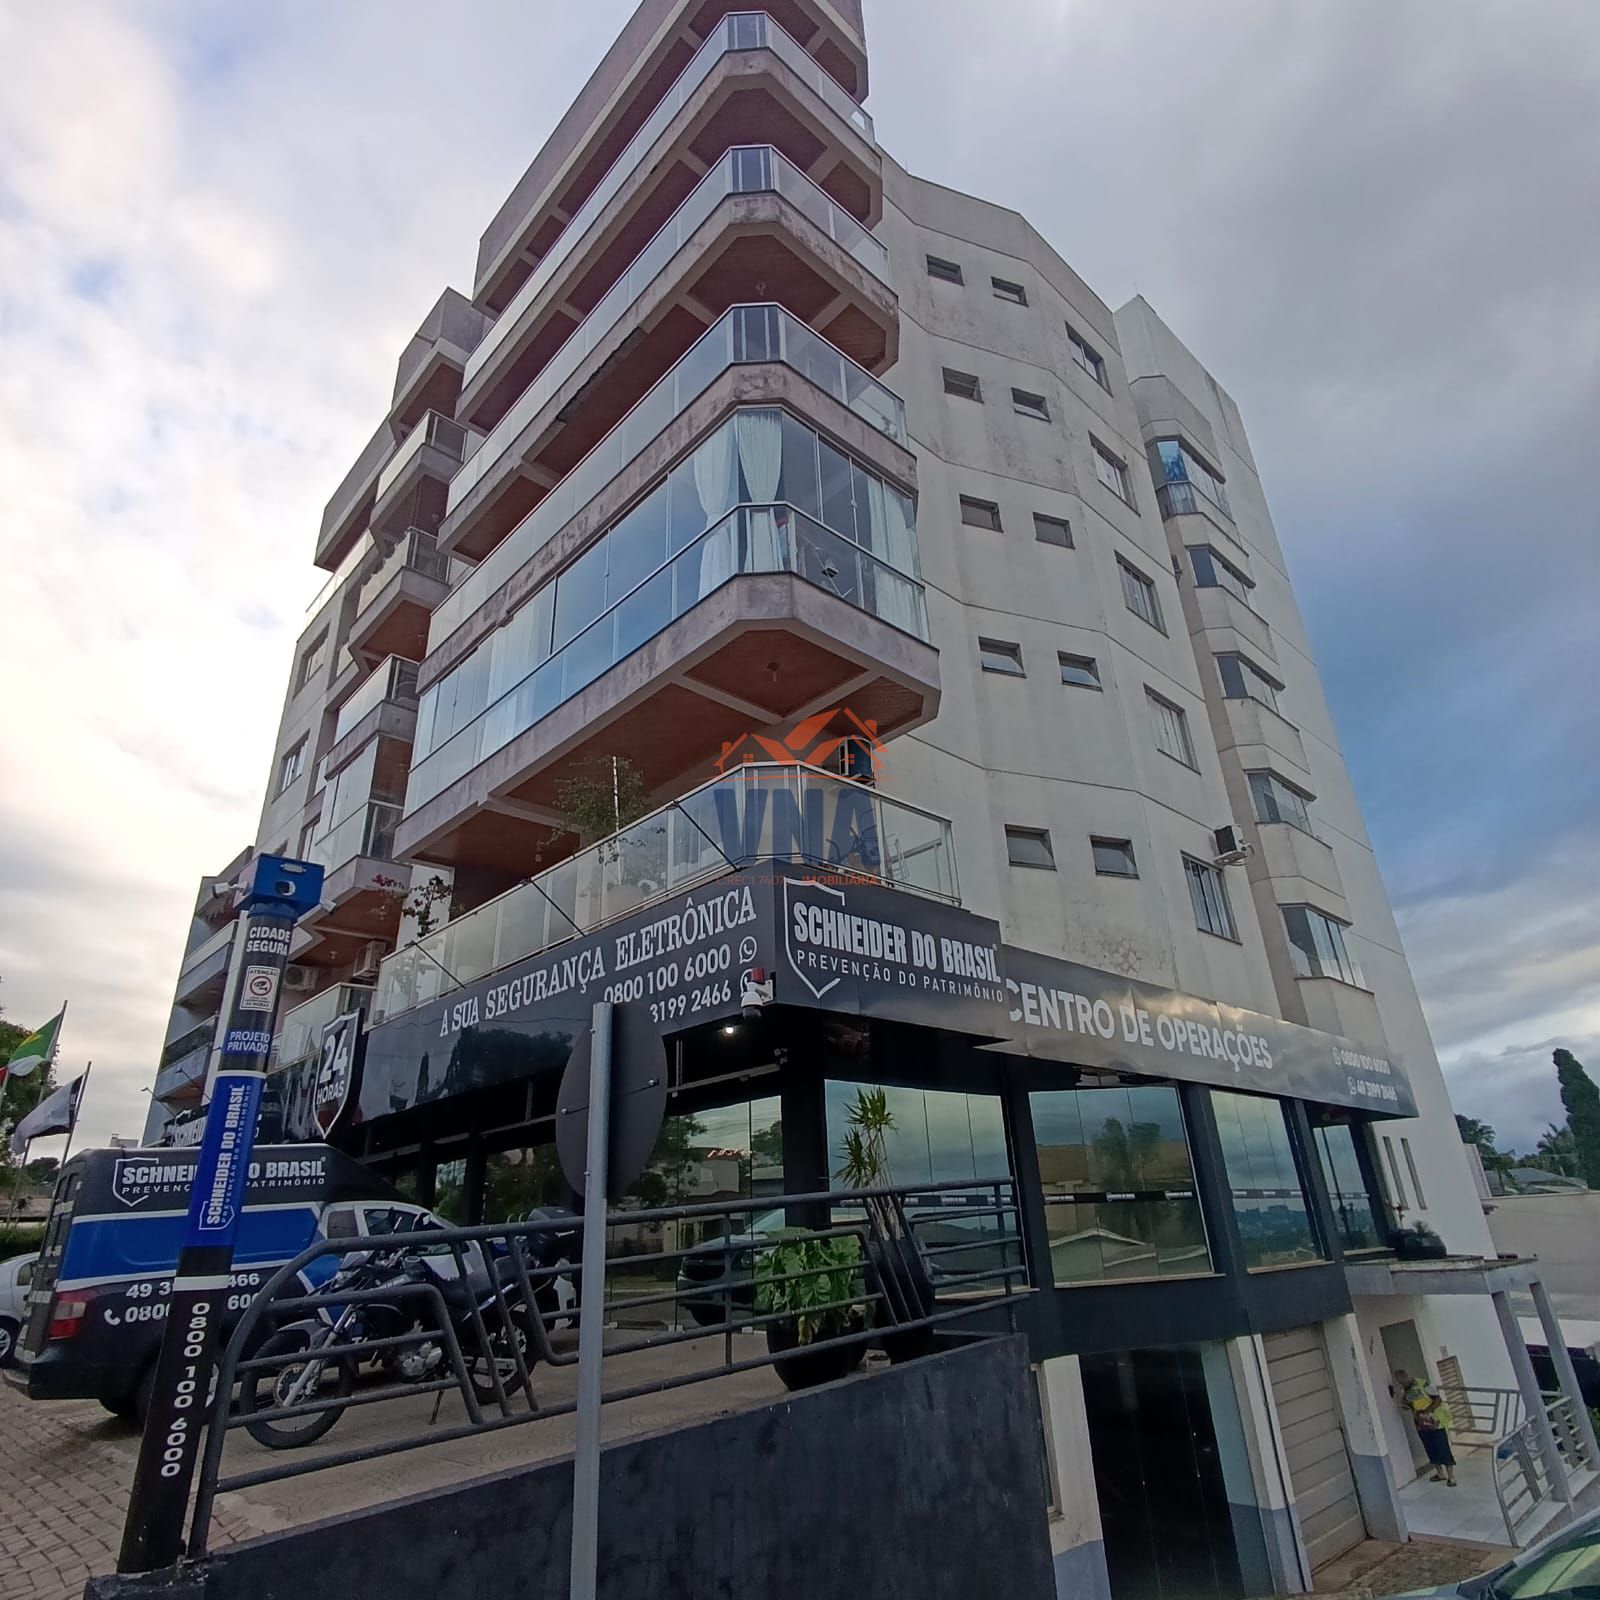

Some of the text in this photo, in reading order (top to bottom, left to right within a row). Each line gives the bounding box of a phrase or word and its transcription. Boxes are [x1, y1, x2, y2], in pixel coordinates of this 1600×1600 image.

[246, 940, 288, 956] SEGURA
[249, 926, 291, 942] CIDADE
[793, 902, 1001, 983] SCHNEIDER DO BRASIL
[439, 886, 757, 1038] A SUA SEGURANÇA ELETRÔNICA
[604, 944, 731, 1004] 0800 100 6000
[797, 949, 1003, 1002] PREVENÇÃO DO PATRIMÔNIO
[650, 980, 731, 1023] 3199 2466
[1006, 978, 1274, 1073] CENTRO DE OPERAÇÕES
[227, 1041, 269, 1053] PRIVADO
[229, 1031, 271, 1043] PROJETO
[319, 1029, 348, 1083] 24
[316, 1080, 345, 1105] HORAS
[207, 1085, 245, 1224] SCHNEIDER DO BRASIL
[221, 1165, 237, 1223] PREVENÇÃO
[237, 1085, 251, 1143] PATRIMÔNIO
[248, 1163, 262, 1178] O
[265, 1161, 325, 1178] BRASIL
[122, 1184, 191, 1195] PREVENÇ
[126, 1283, 152, 1299] 49
[228, 1273, 260, 1288] 466
[161, 1302, 210, 1477] 0800 100 6000
